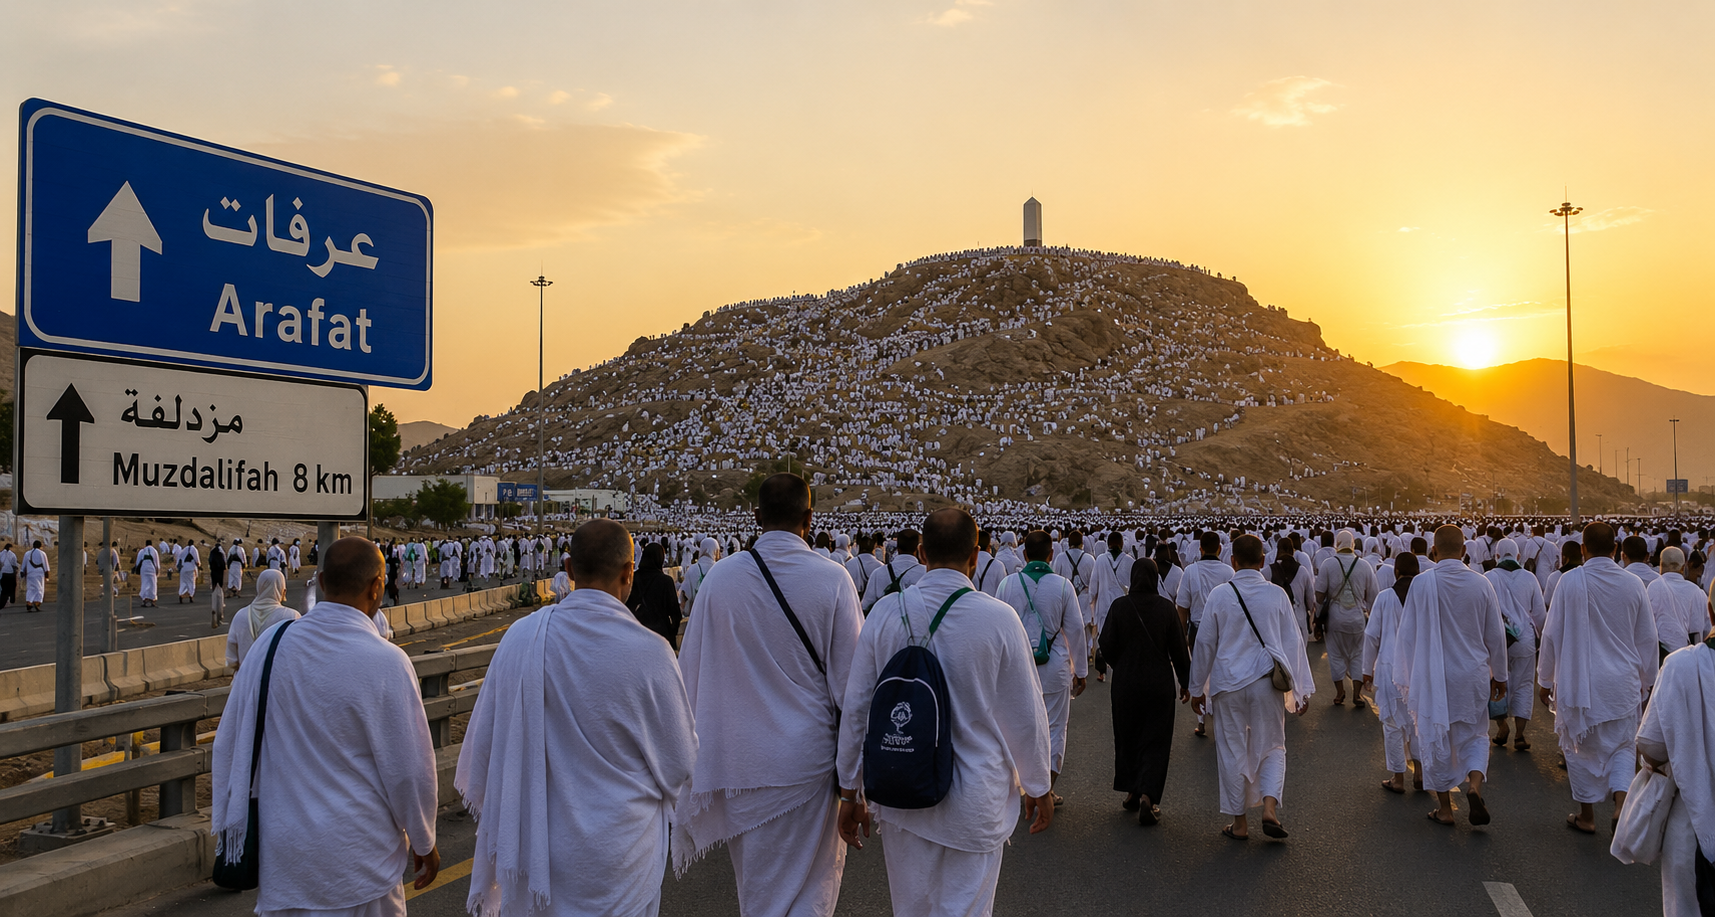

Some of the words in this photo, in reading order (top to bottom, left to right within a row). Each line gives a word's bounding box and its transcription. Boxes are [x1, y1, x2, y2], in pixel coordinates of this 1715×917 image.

[202, 194, 379, 277] عرفات
[209, 283, 372, 354] Arafat
[120, 388, 244, 443] مزدلفة
[112, 452, 279, 492] Muzdalifah
[292, 463, 309, 493] 8
[316, 464, 352, 494] km
